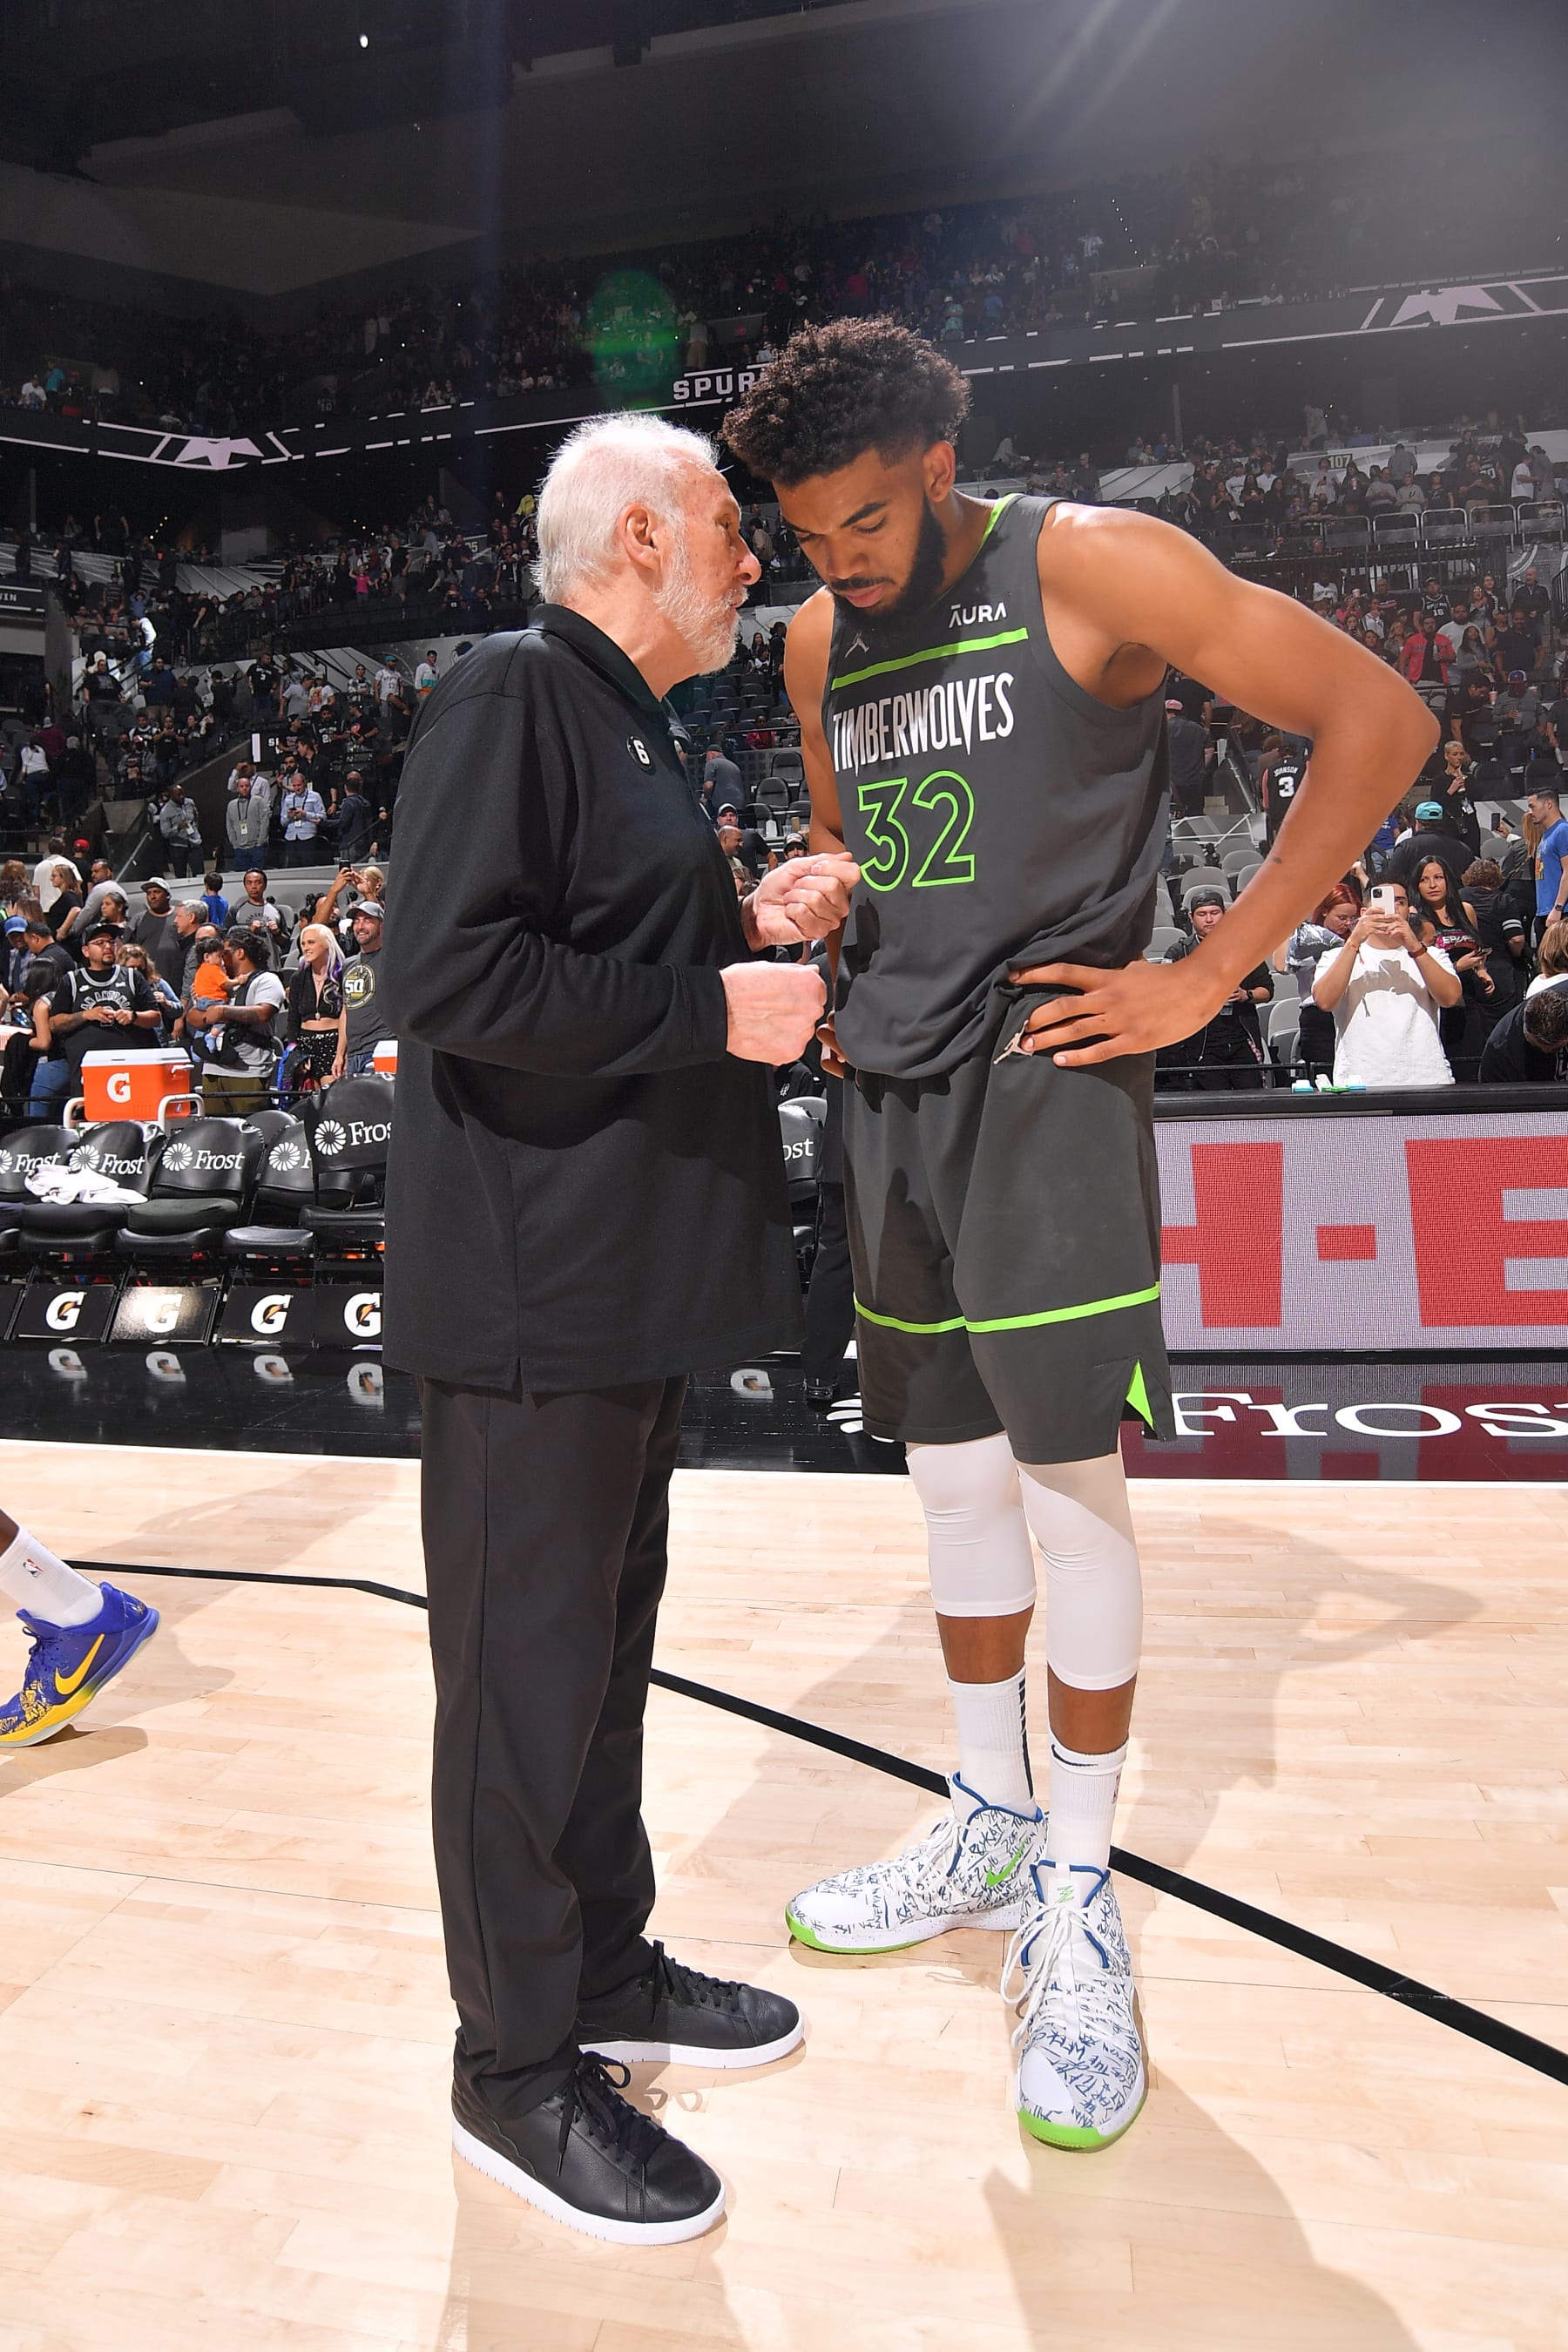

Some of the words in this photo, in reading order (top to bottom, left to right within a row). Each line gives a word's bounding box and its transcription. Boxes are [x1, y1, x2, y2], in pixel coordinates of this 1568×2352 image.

[673, 372, 755, 400] SPUR
[1328, 456, 1350, 469] 107
[833, 672, 1015, 777] TIMBERWOLVES
[633, 740, 650, 764] 6
[1274, 766, 1299, 777] JOHNSON
[1278, 776, 1294, 798] 3
[857, 770, 975, 892] 32
[345, 978, 364, 994] 50
[106, 1072, 132, 1103] G
[98, 1152, 145, 1175] Frost
[193, 1149, 245, 1170] Frost
[46, 1291, 87, 1330] G
[251, 1294, 294, 1334] G
[344, 1292, 382, 1337] G
